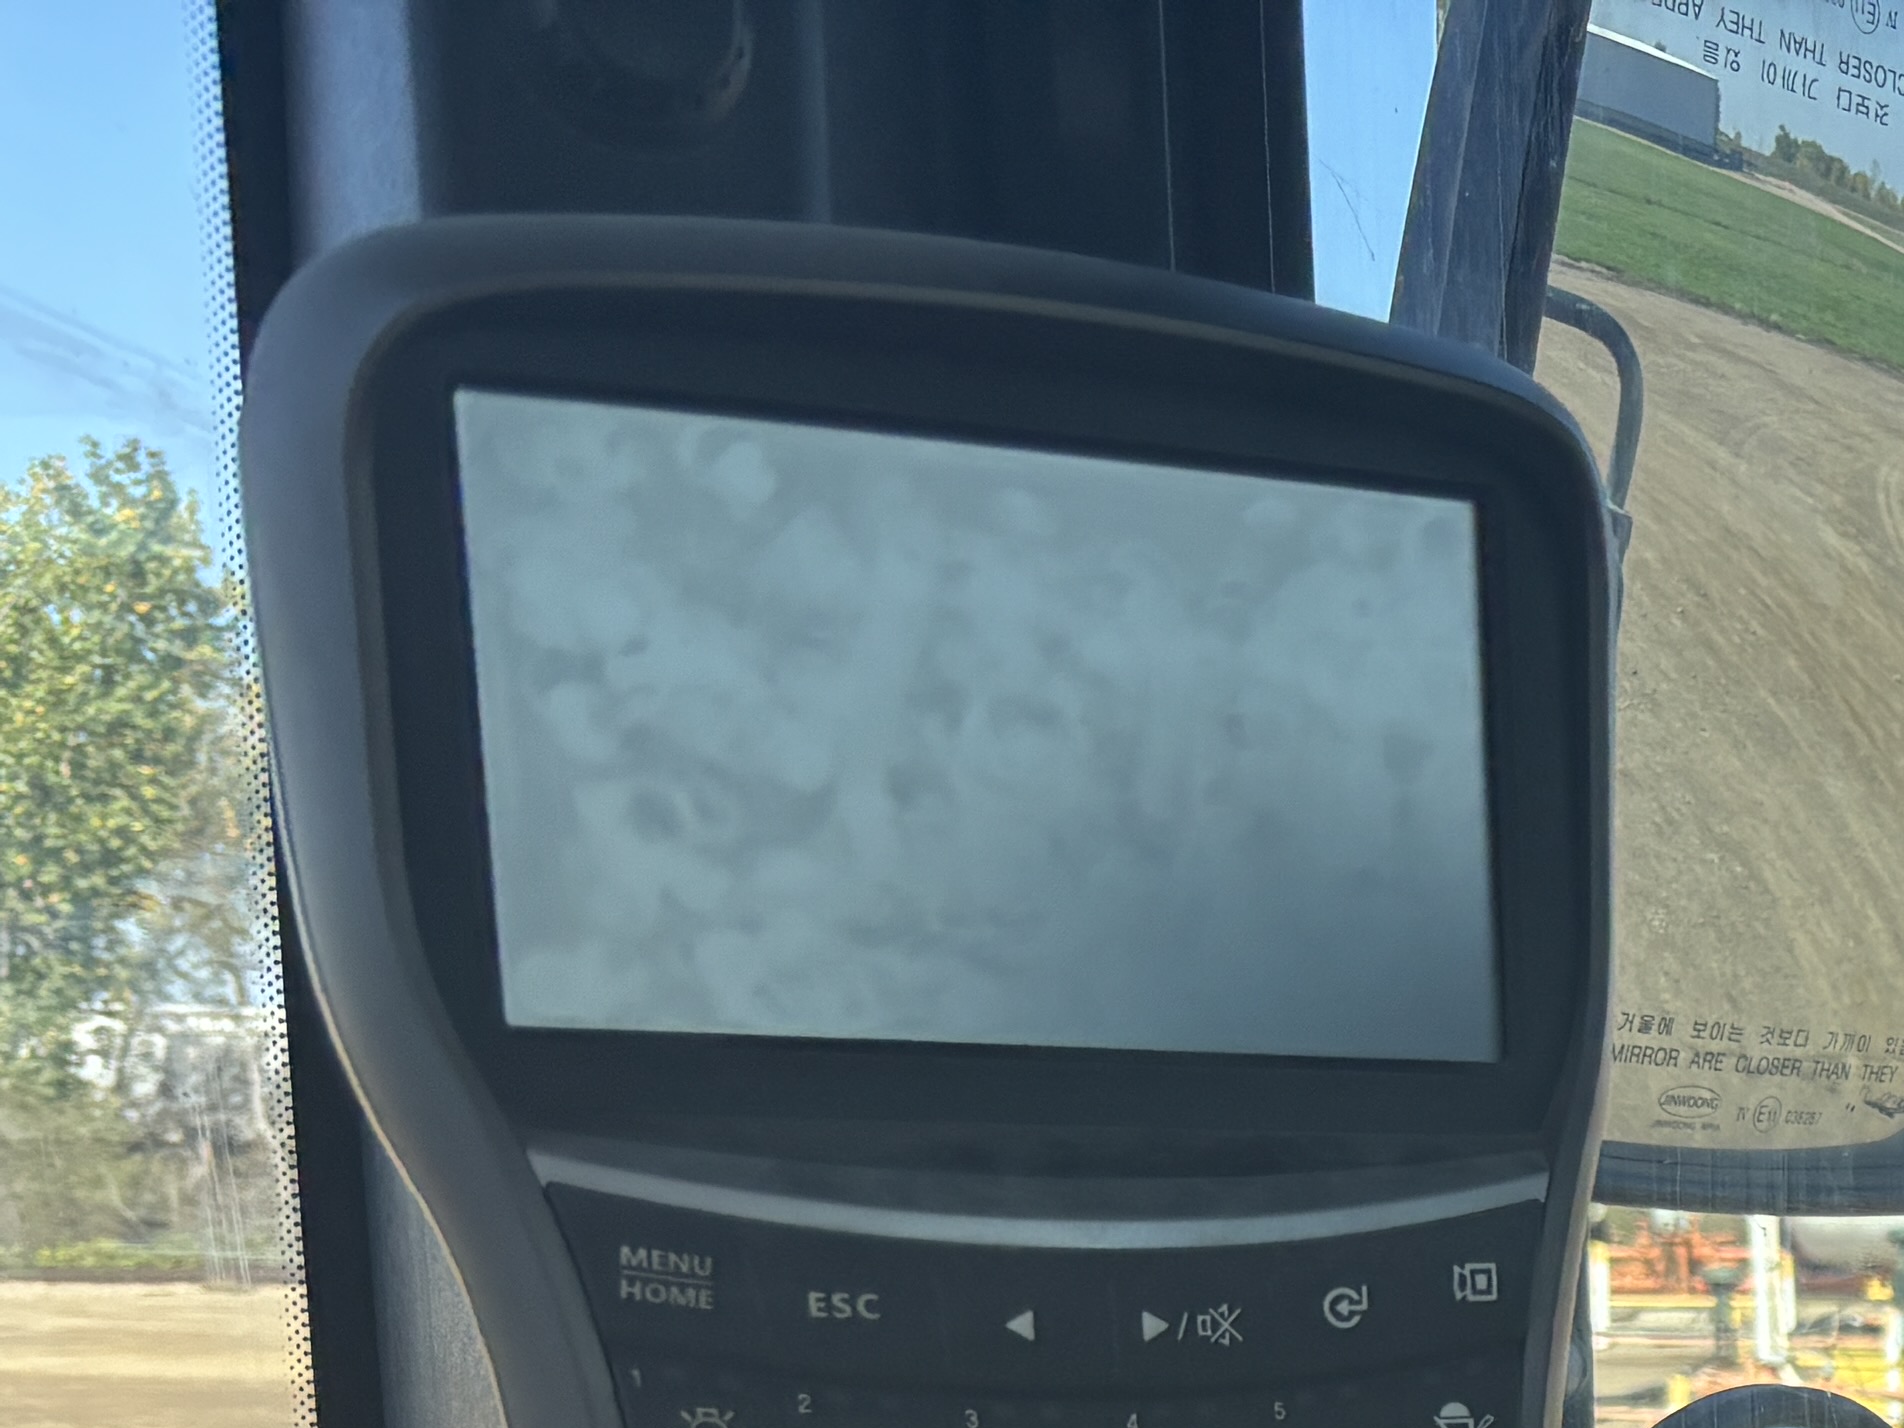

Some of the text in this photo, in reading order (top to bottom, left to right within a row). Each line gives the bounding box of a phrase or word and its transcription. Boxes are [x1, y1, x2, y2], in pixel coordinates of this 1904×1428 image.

[1716, 9, 1768, 44] THEY
[1779, 29, 1828, 66] THAN
[1760, 58, 1821, 100] 가까이
[1836, 88, 1891, 126] 것보다
[1616, 1012, 1675, 1037] 거울에
[1691, 1020, 1745, 1044] 보이는
[1759, 1026, 1809, 1047] 것보다
[1822, 1031, 1872, 1053] 가까이
[1613, 1043, 1680, 1068] MIRROR
[1688, 1052, 1724, 1072] ARE
[1735, 1055, 1802, 1077] CLOSER
[1811, 1061, 1851, 1081] THAN
[1861, 1064, 1898, 1083] THEY
[620, 1244, 714, 1276] MENU
[620, 1277, 715, 1311] HOME
[807, 1291, 880, 1320] ESC
[797, 1394, 811, 1414] 2
[965, 1410, 979, 1428] 3
[1273, 1402, 1286, 1421] 5
